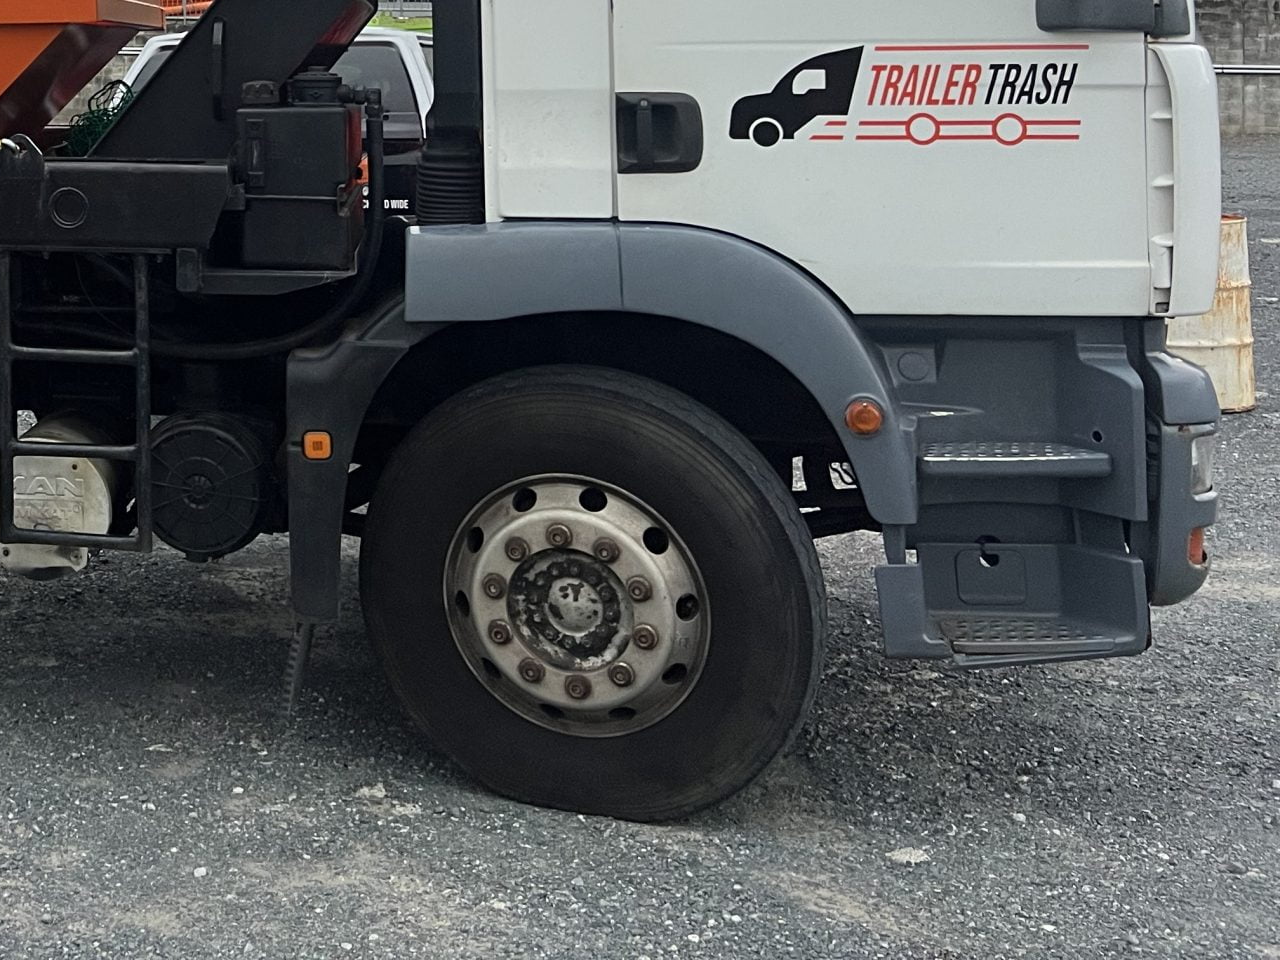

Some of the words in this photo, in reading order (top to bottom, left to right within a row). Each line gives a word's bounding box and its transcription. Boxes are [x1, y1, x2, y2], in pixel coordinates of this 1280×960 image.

[867, 64, 983, 107] TRAILER
[984, 62, 1080, 105] TRASH
[390, 199, 409, 209] WIDE
